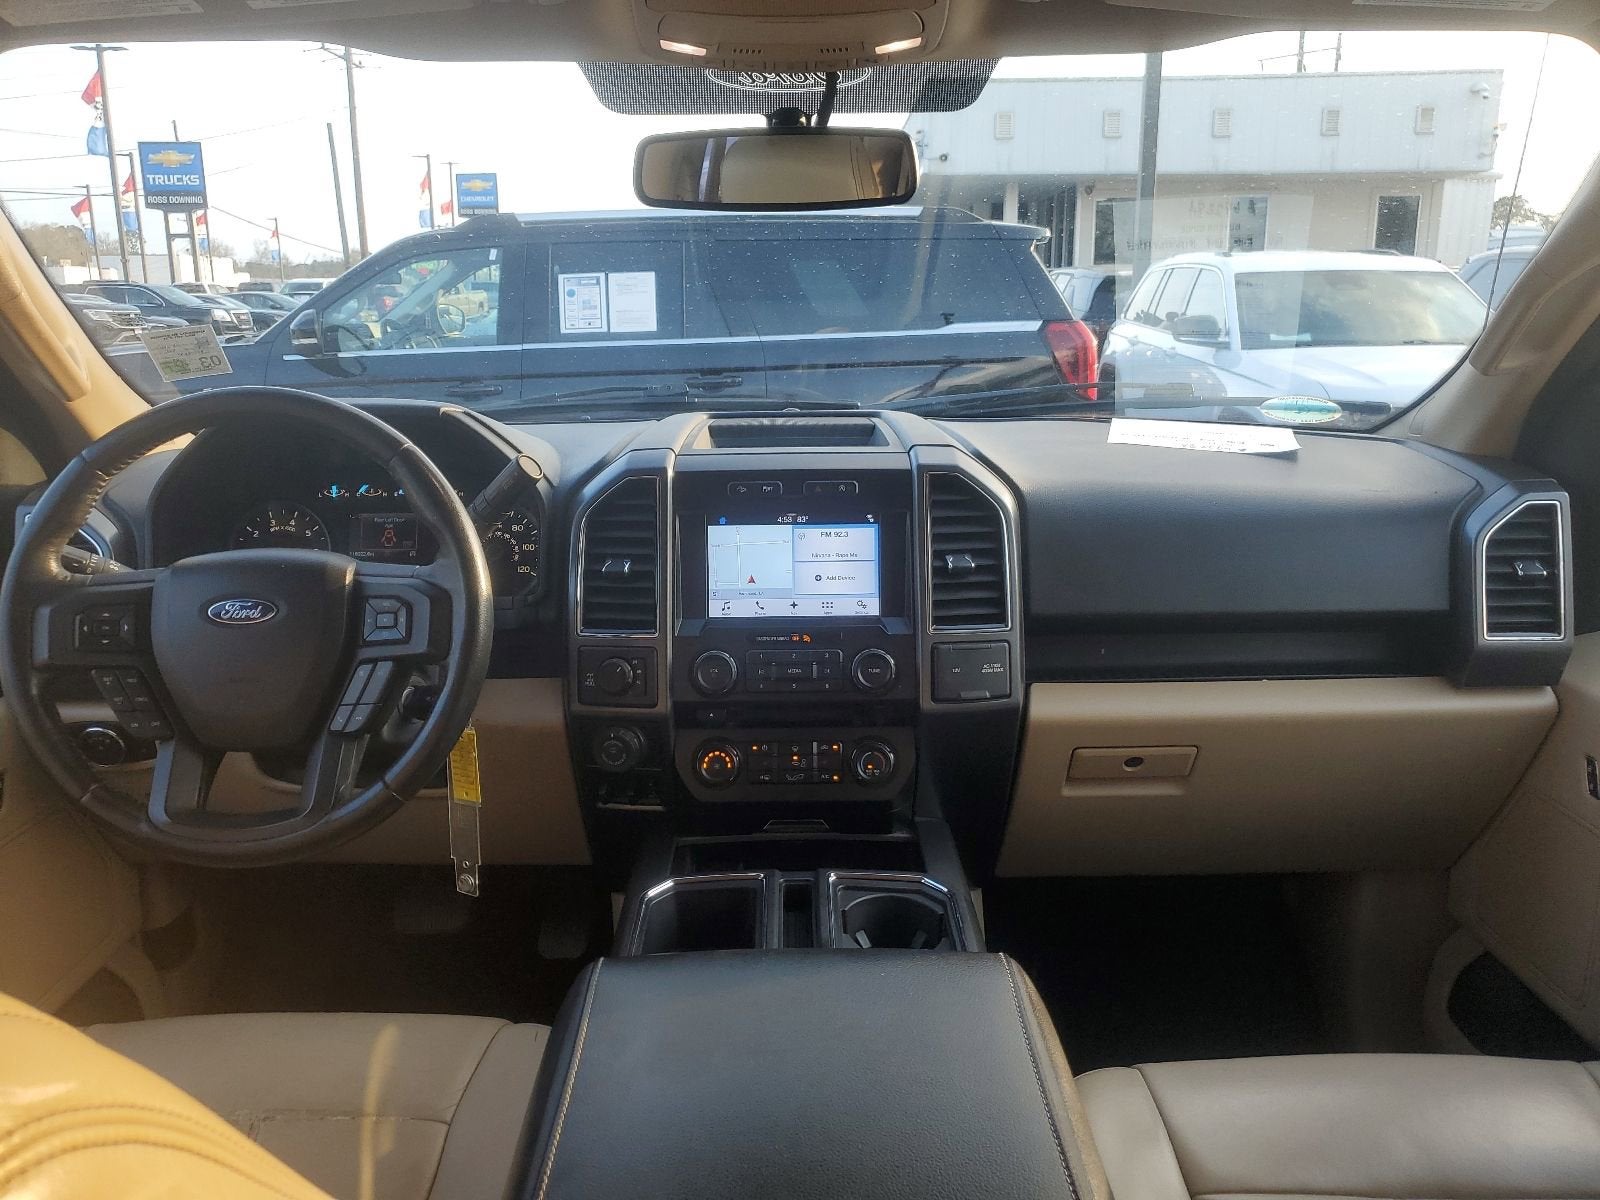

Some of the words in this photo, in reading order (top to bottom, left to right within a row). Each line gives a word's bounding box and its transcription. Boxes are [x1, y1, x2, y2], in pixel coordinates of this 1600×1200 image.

[146, 174, 200, 185] TRUCKS
[147, 195, 168, 204] ROSS
[169, 195, 203, 204] DOWNING
[511, 524, 524, 532] 80
[253, 530, 259, 538] 2
[305, 529, 312, 537] 5
[522, 543, 535, 551] 100
[517, 565, 530, 573] 120
[220, 602, 263, 619] Ford
